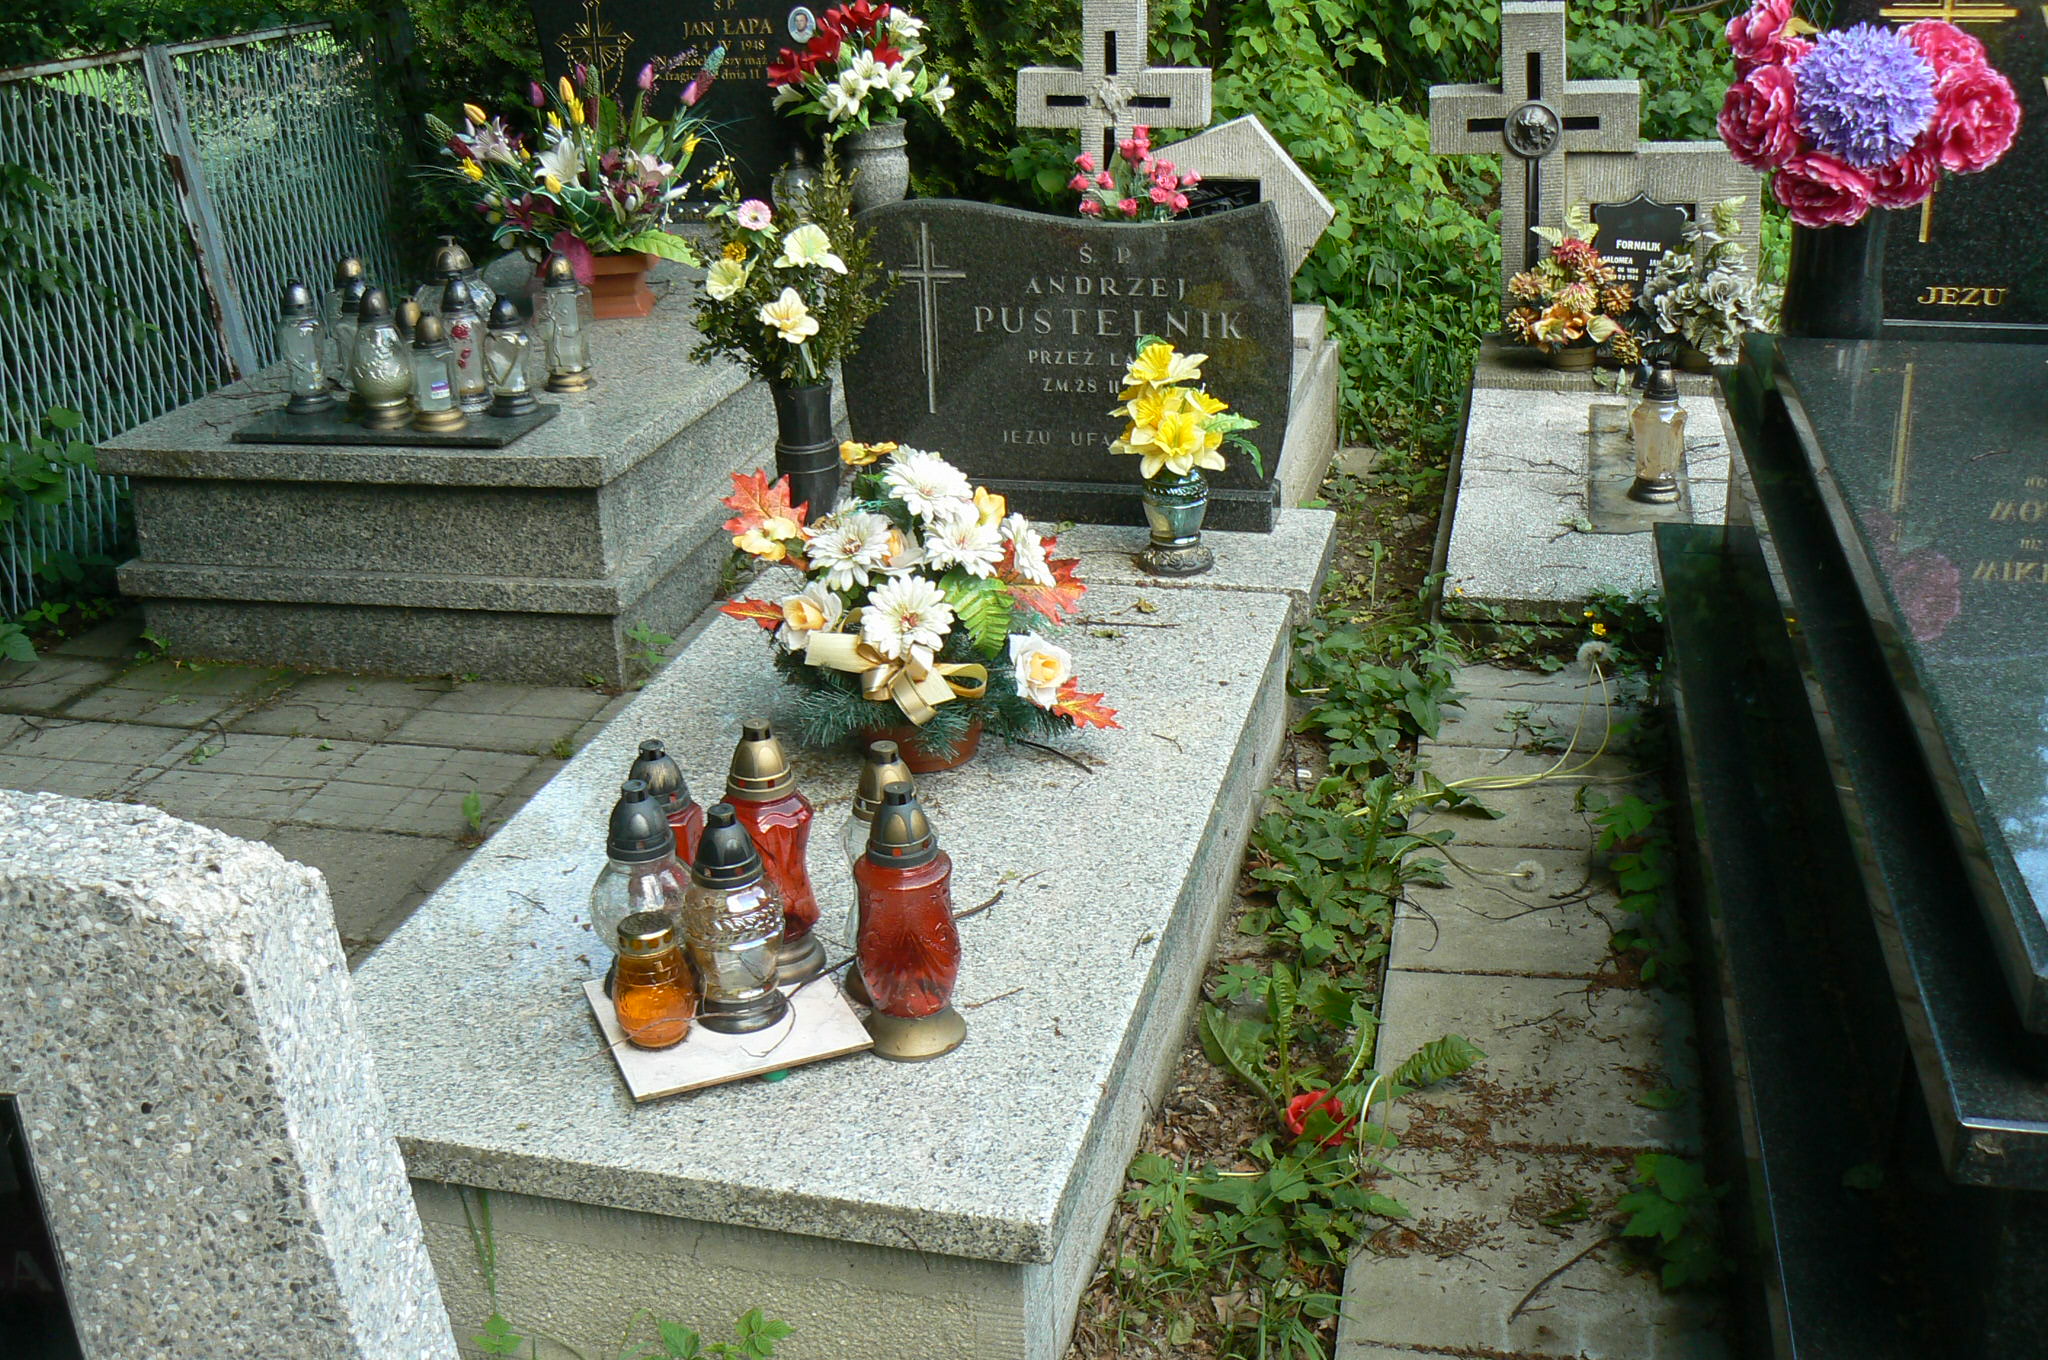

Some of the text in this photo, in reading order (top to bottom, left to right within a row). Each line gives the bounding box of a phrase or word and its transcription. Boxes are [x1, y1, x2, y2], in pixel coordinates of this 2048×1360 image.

[682, 17, 774, 40] JAN ŁAPA
[1616, 239, 1661, 252] FORNALIK
[1602, 255, 1633, 265] SALOMEA
[1025, 275, 1186, 301] ANDRZEJ
[1917, 285, 2007, 308] JEZU
[974, 305, 1243, 340] PUSTELNIK
[1003, 430, 1050, 445] JEZU
